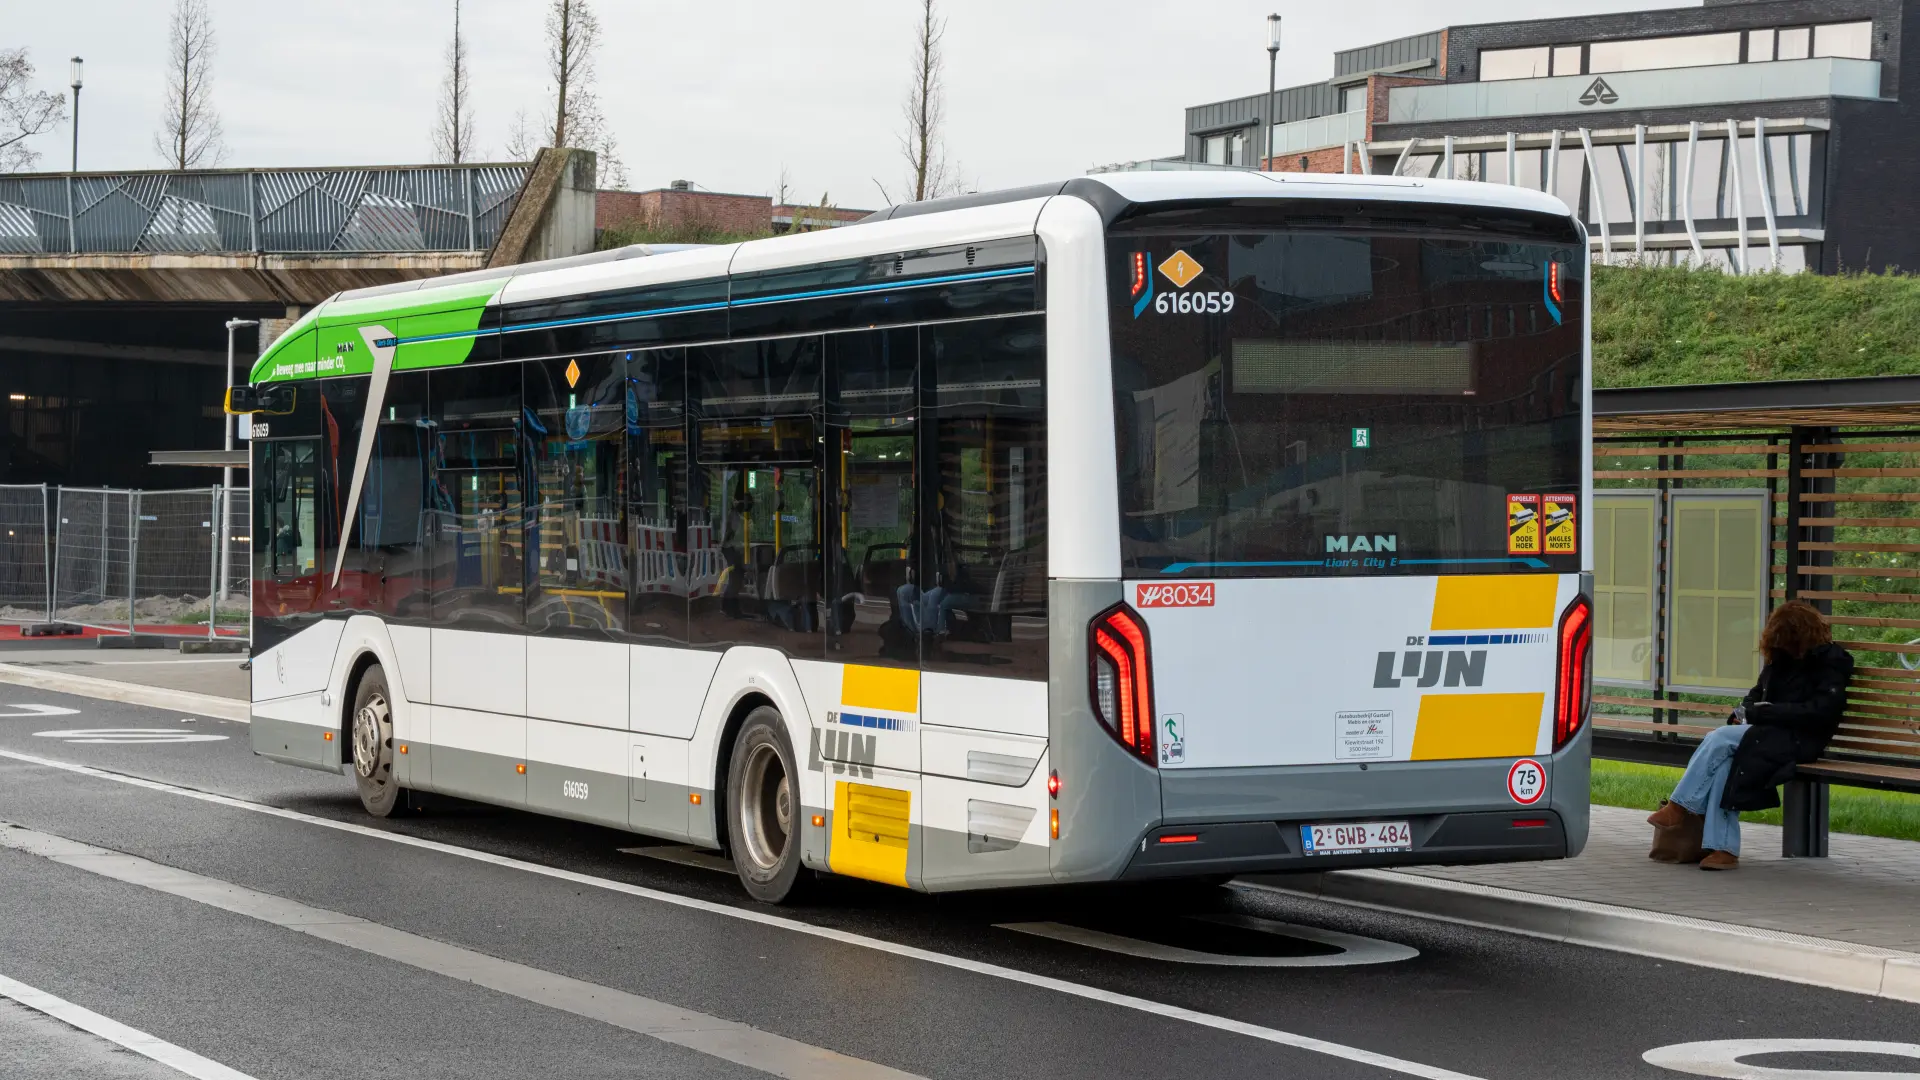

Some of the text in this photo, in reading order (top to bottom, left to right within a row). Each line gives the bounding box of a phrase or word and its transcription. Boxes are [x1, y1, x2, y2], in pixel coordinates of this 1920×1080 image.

[1155, 292, 1235, 314] 616059
[337, 342, 354, 353] MAN
[276, 363, 294, 378] Beweeg
[294, 363, 304, 374] mee
[305, 361, 317, 372] naar
[252, 422, 269, 438] 616059
[1326, 535, 1397, 553] MAN
[1325, 557, 1398, 569] Lion's City E
[1406, 636, 1425, 646] DE
[1373, 650, 1488, 688] LIJN
[827, 711, 838, 723] DE
[808, 727, 876, 779] LIJN
[1517, 769, 1537, 785] 75
[563, 780, 588, 799] 616059
[1520, 787, 1533, 795] km
[1305, 840, 1312, 849] B
